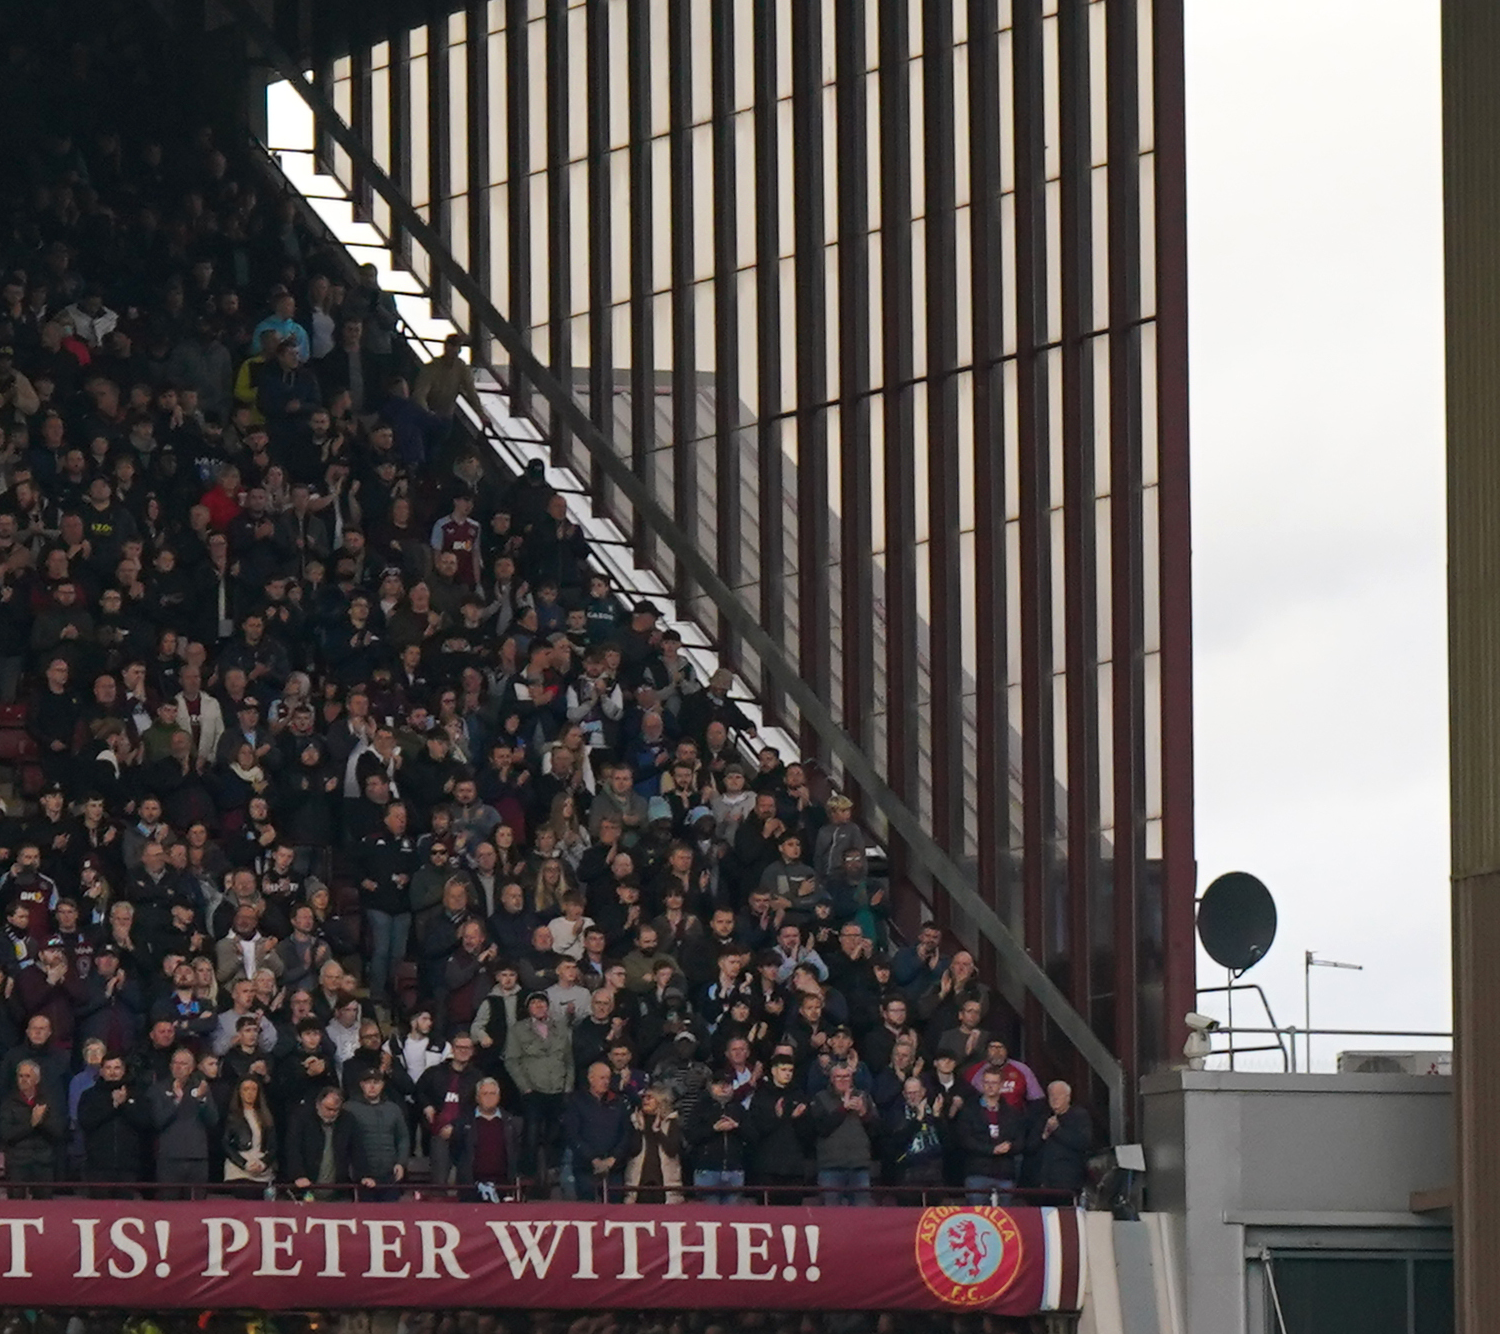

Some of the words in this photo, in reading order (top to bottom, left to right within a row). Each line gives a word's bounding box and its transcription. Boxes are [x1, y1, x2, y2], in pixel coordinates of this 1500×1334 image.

[921, 1206, 960, 1244] ASTON
[974, 1206, 1015, 1242] VILLA
[73, 1218, 170, 1277] IS!
[202, 1217, 469, 1278] PETER
[486, 1220, 820, 1281] WITHE!!
[952, 1286, 984, 1301] F.C.
